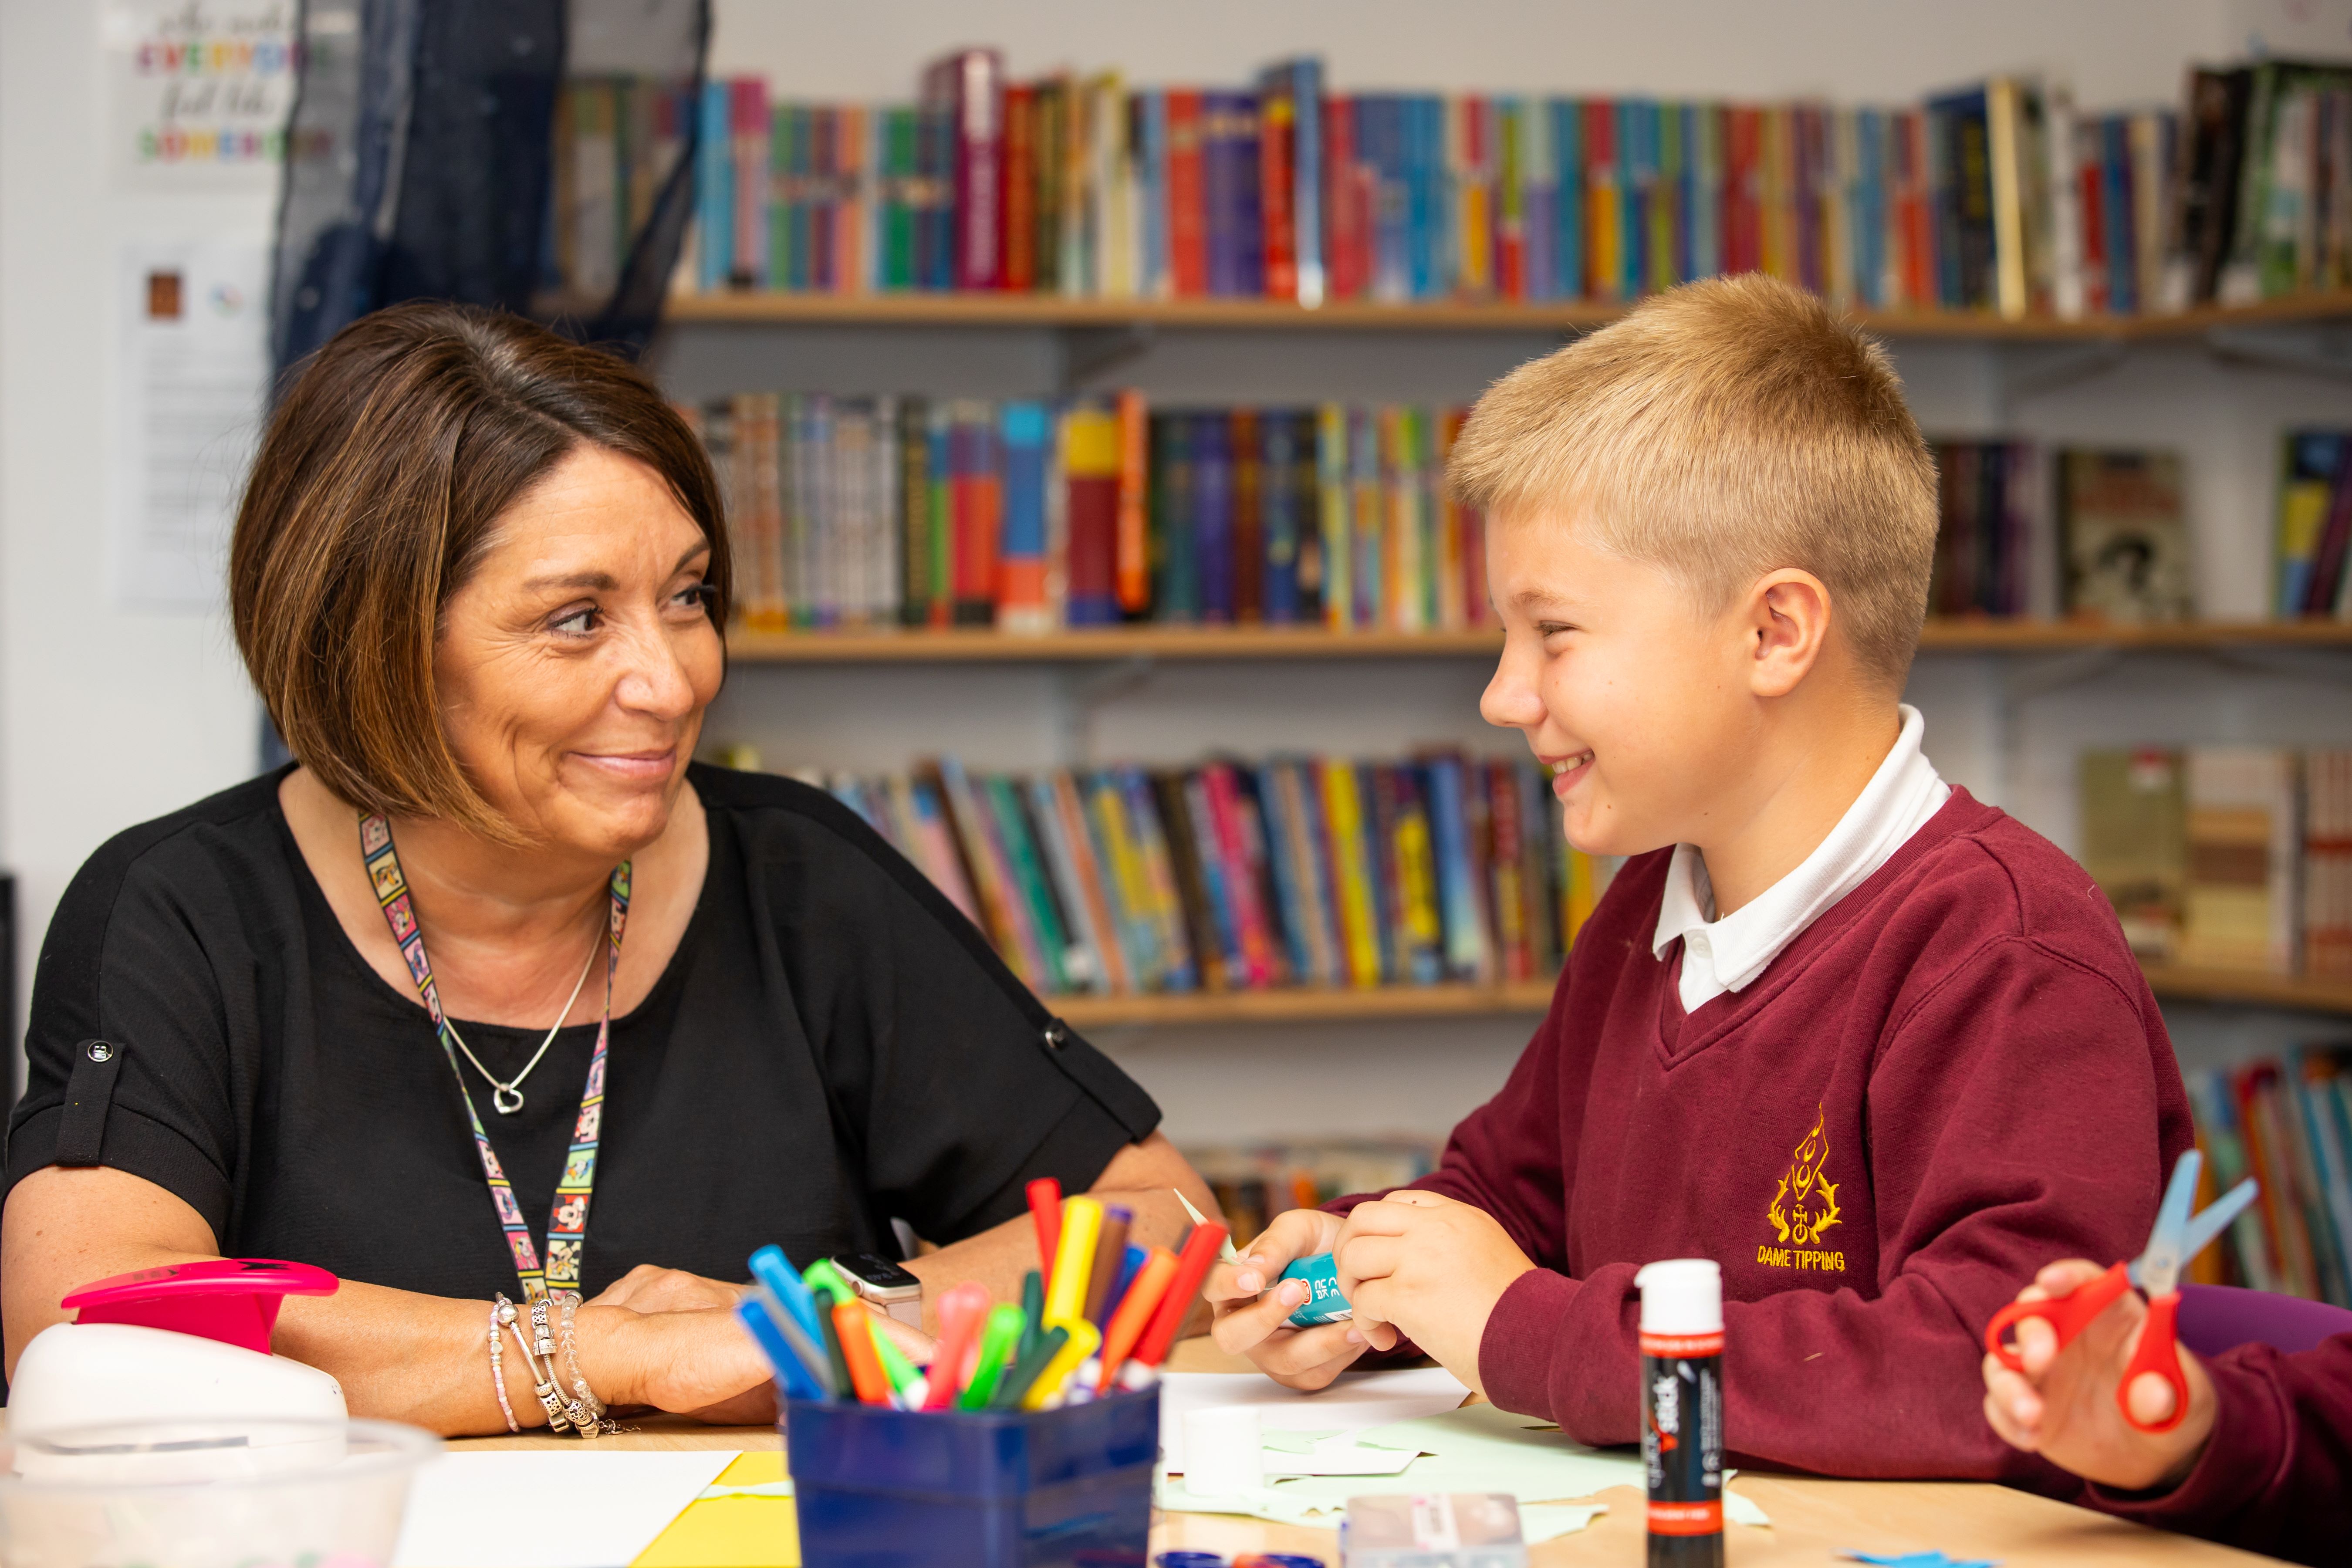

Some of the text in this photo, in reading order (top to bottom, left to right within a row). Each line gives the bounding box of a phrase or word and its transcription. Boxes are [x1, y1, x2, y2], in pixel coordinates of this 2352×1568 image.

[1757, 1245, 1845, 1272] DAME TIPPING
[1652, 1375, 1680, 1434] stick
